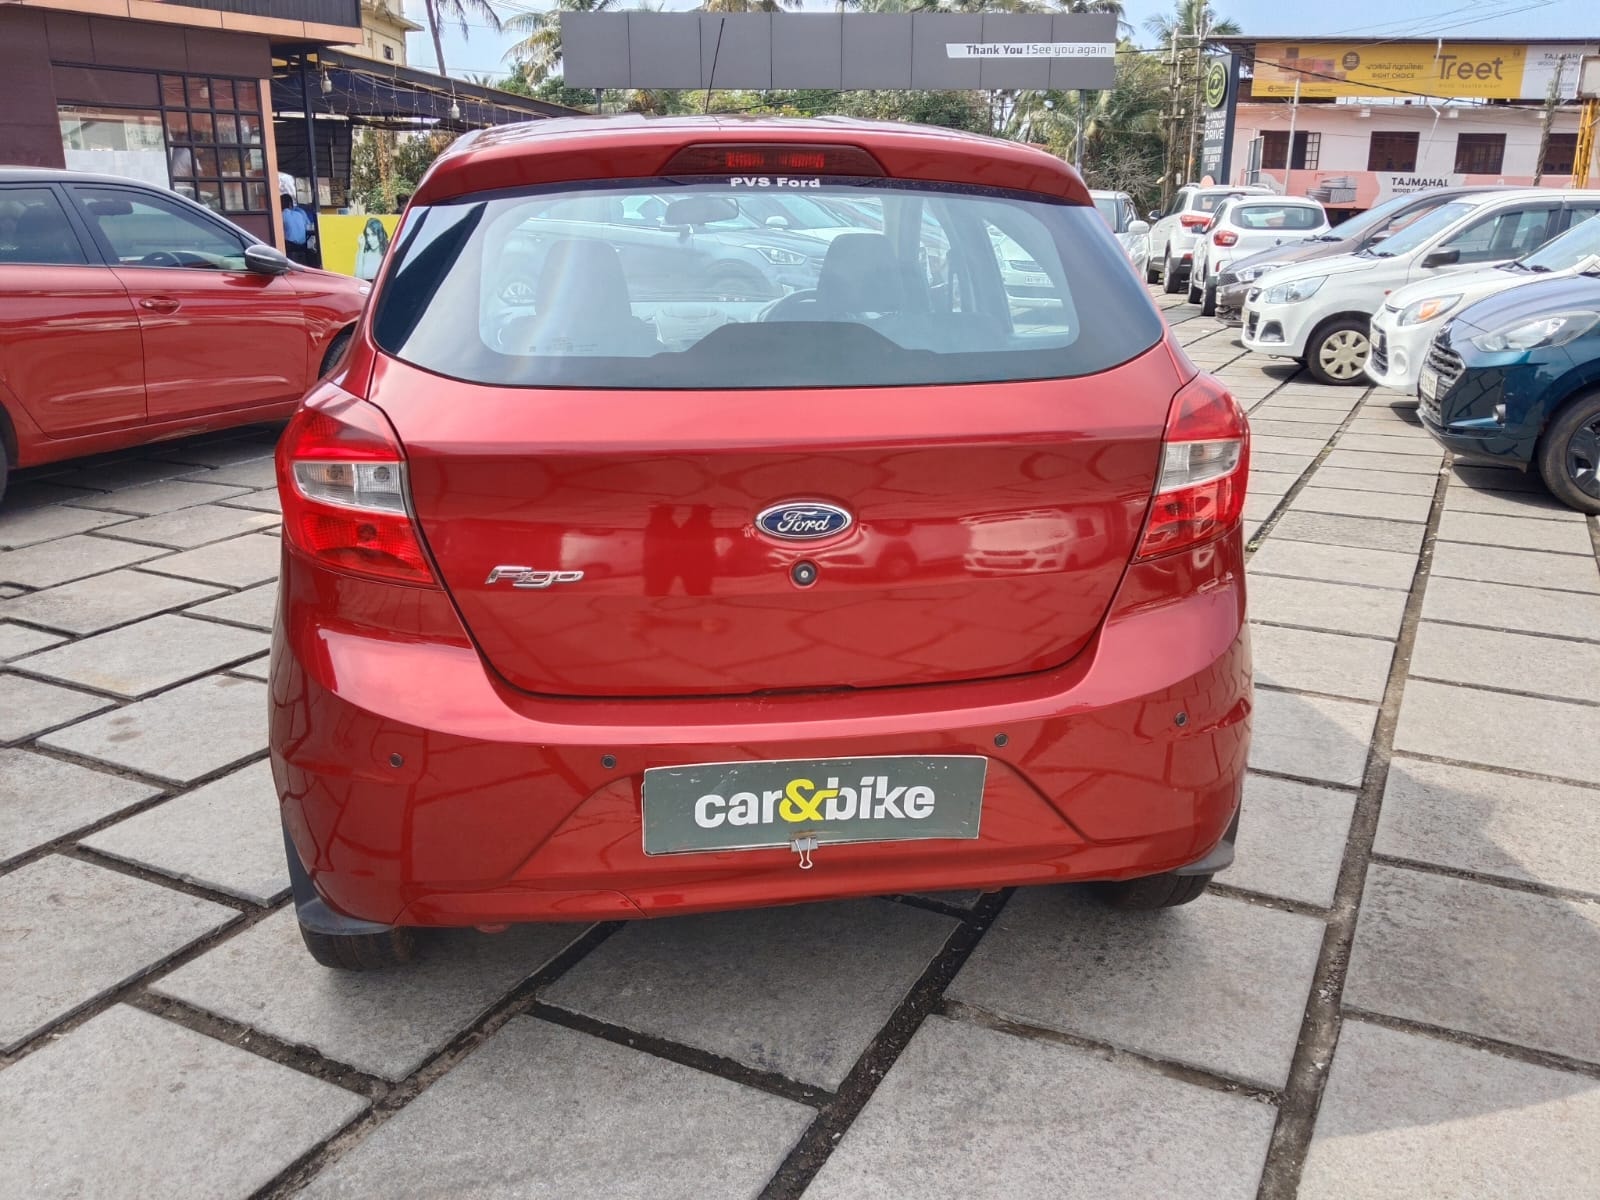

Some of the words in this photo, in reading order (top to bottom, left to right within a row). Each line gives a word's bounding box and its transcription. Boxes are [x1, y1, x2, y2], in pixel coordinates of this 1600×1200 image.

[966, 45, 999, 55] Thank
[1003, 45, 1023, 55] You
[1031, 44, 1051, 54] See
[1054, 46, 1075, 56] you
[1077, 44, 1107, 56] again
[1433, 54, 1503, 80] Treet
[1204, 128, 1224, 141] DRIVE
[730, 177, 771, 187] PVS
[776, 177, 821, 188] Ford
[1392, 177, 1448, 187] TAJMAHAL
[776, 510, 830, 532] Ford
[485, 565, 584, 588] Figo
[694, 776, 936, 828] car&bike
